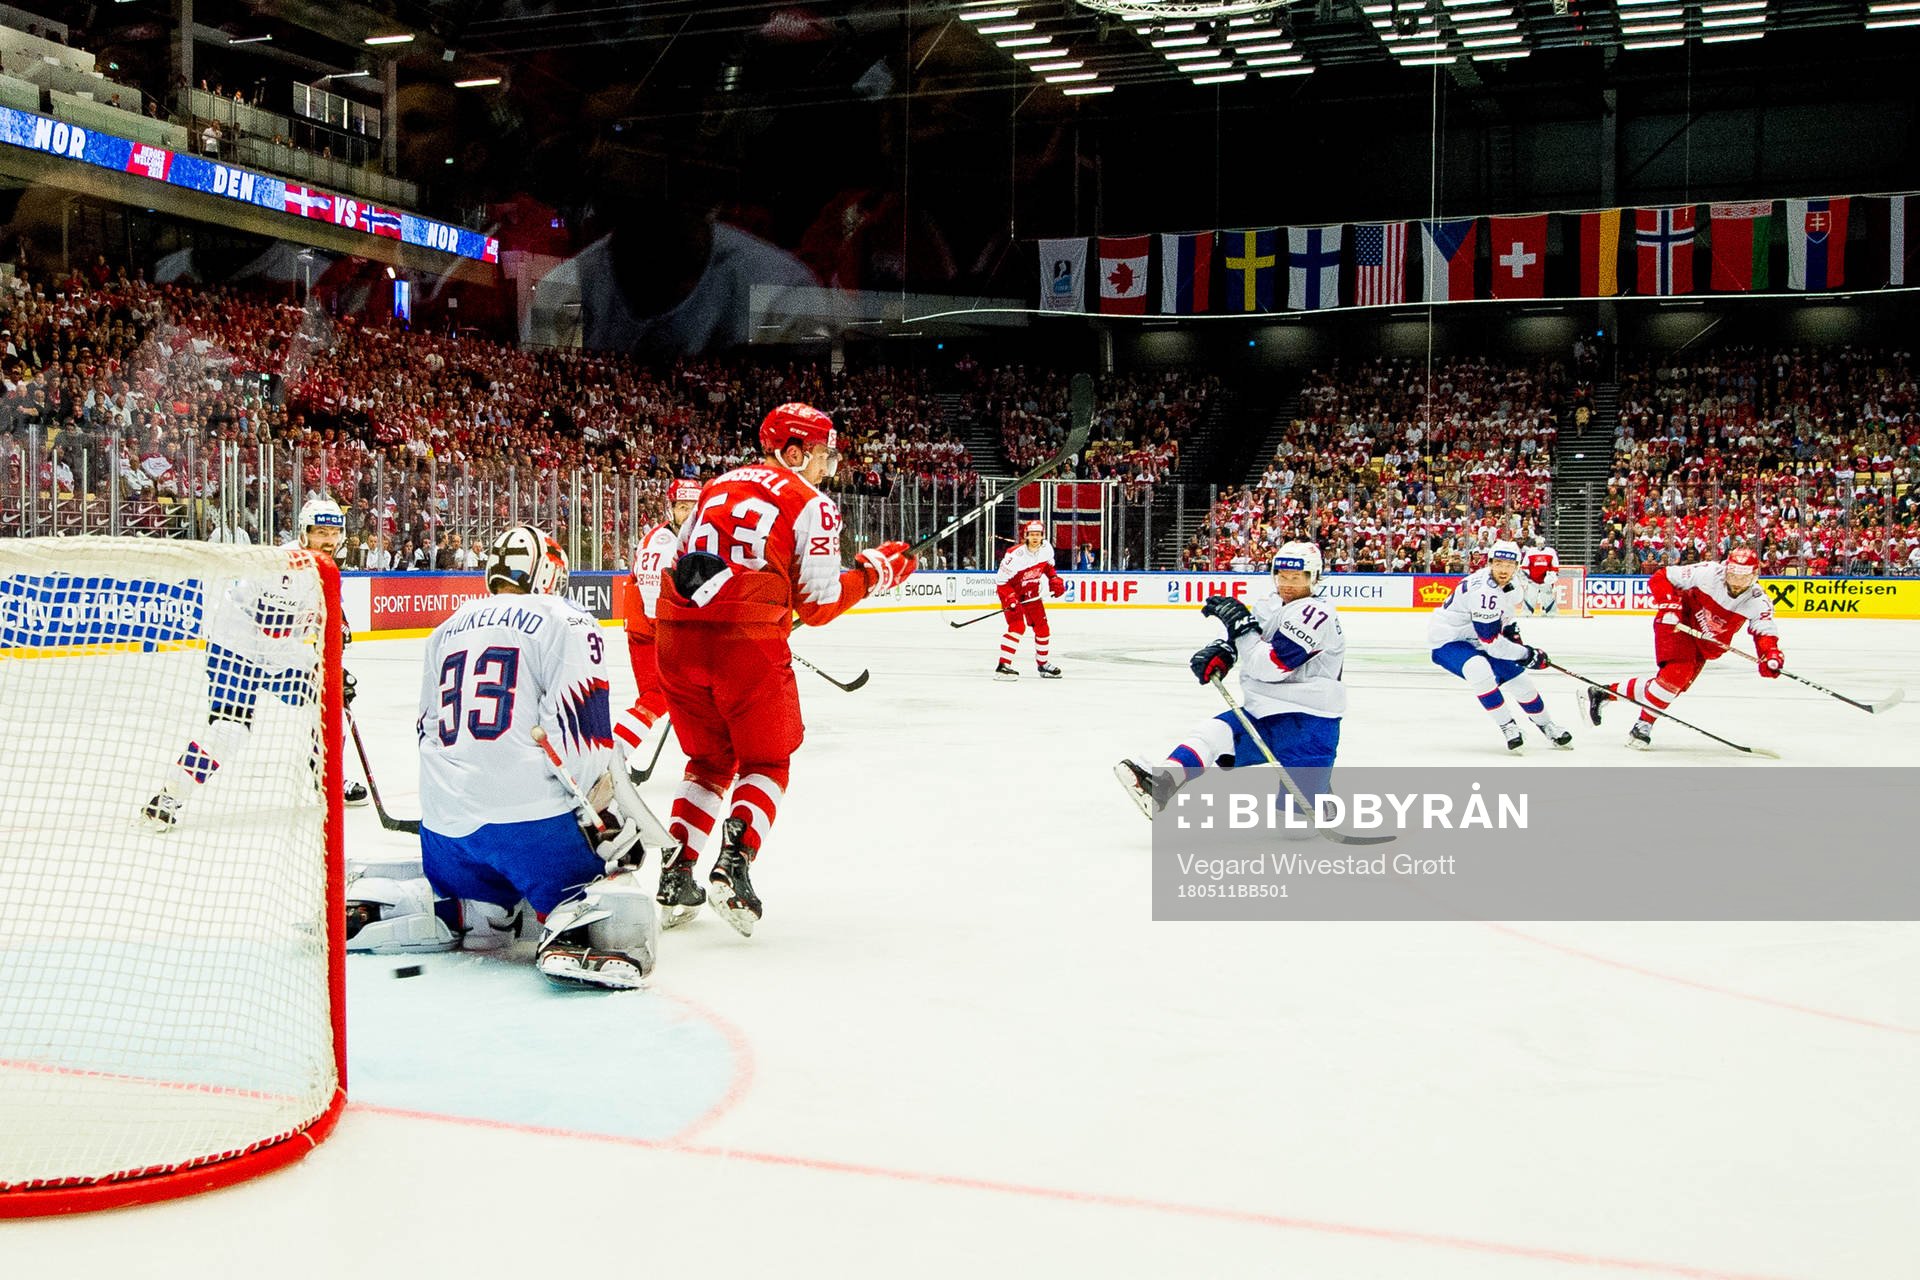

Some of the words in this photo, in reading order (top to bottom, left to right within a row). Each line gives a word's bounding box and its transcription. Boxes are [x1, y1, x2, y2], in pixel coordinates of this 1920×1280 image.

[35, 117, 86, 159] NOR
[213, 165, 255, 201] DEN
[335, 196, 358, 228] VS
[427, 222, 459, 253] NOR
[688, 493, 780, 571] 63
[641, 552, 661, 571] 27
[905, 581, 942, 596] ŠKODA
[965, 576, 996, 585] Downloa
[1803, 580, 1897, 595] Raiffeisen
[961, 588, 986, 597] Official
[1080, 581, 1138, 602] IIHF
[1185, 581, 1248, 602] IIHF
[1317, 585, 1383, 598] ZURICH
[1481, 594, 1498, 610] 16
[62, 593, 92, 627] of
[99, 593, 197, 630] Herning
[373, 595, 411, 613] SPORT
[414, 594, 448, 612] EVENT
[1803, 599, 1861, 612] BANK
[1302, 604, 1329, 631] 47
[438, 646, 521, 747] 33
